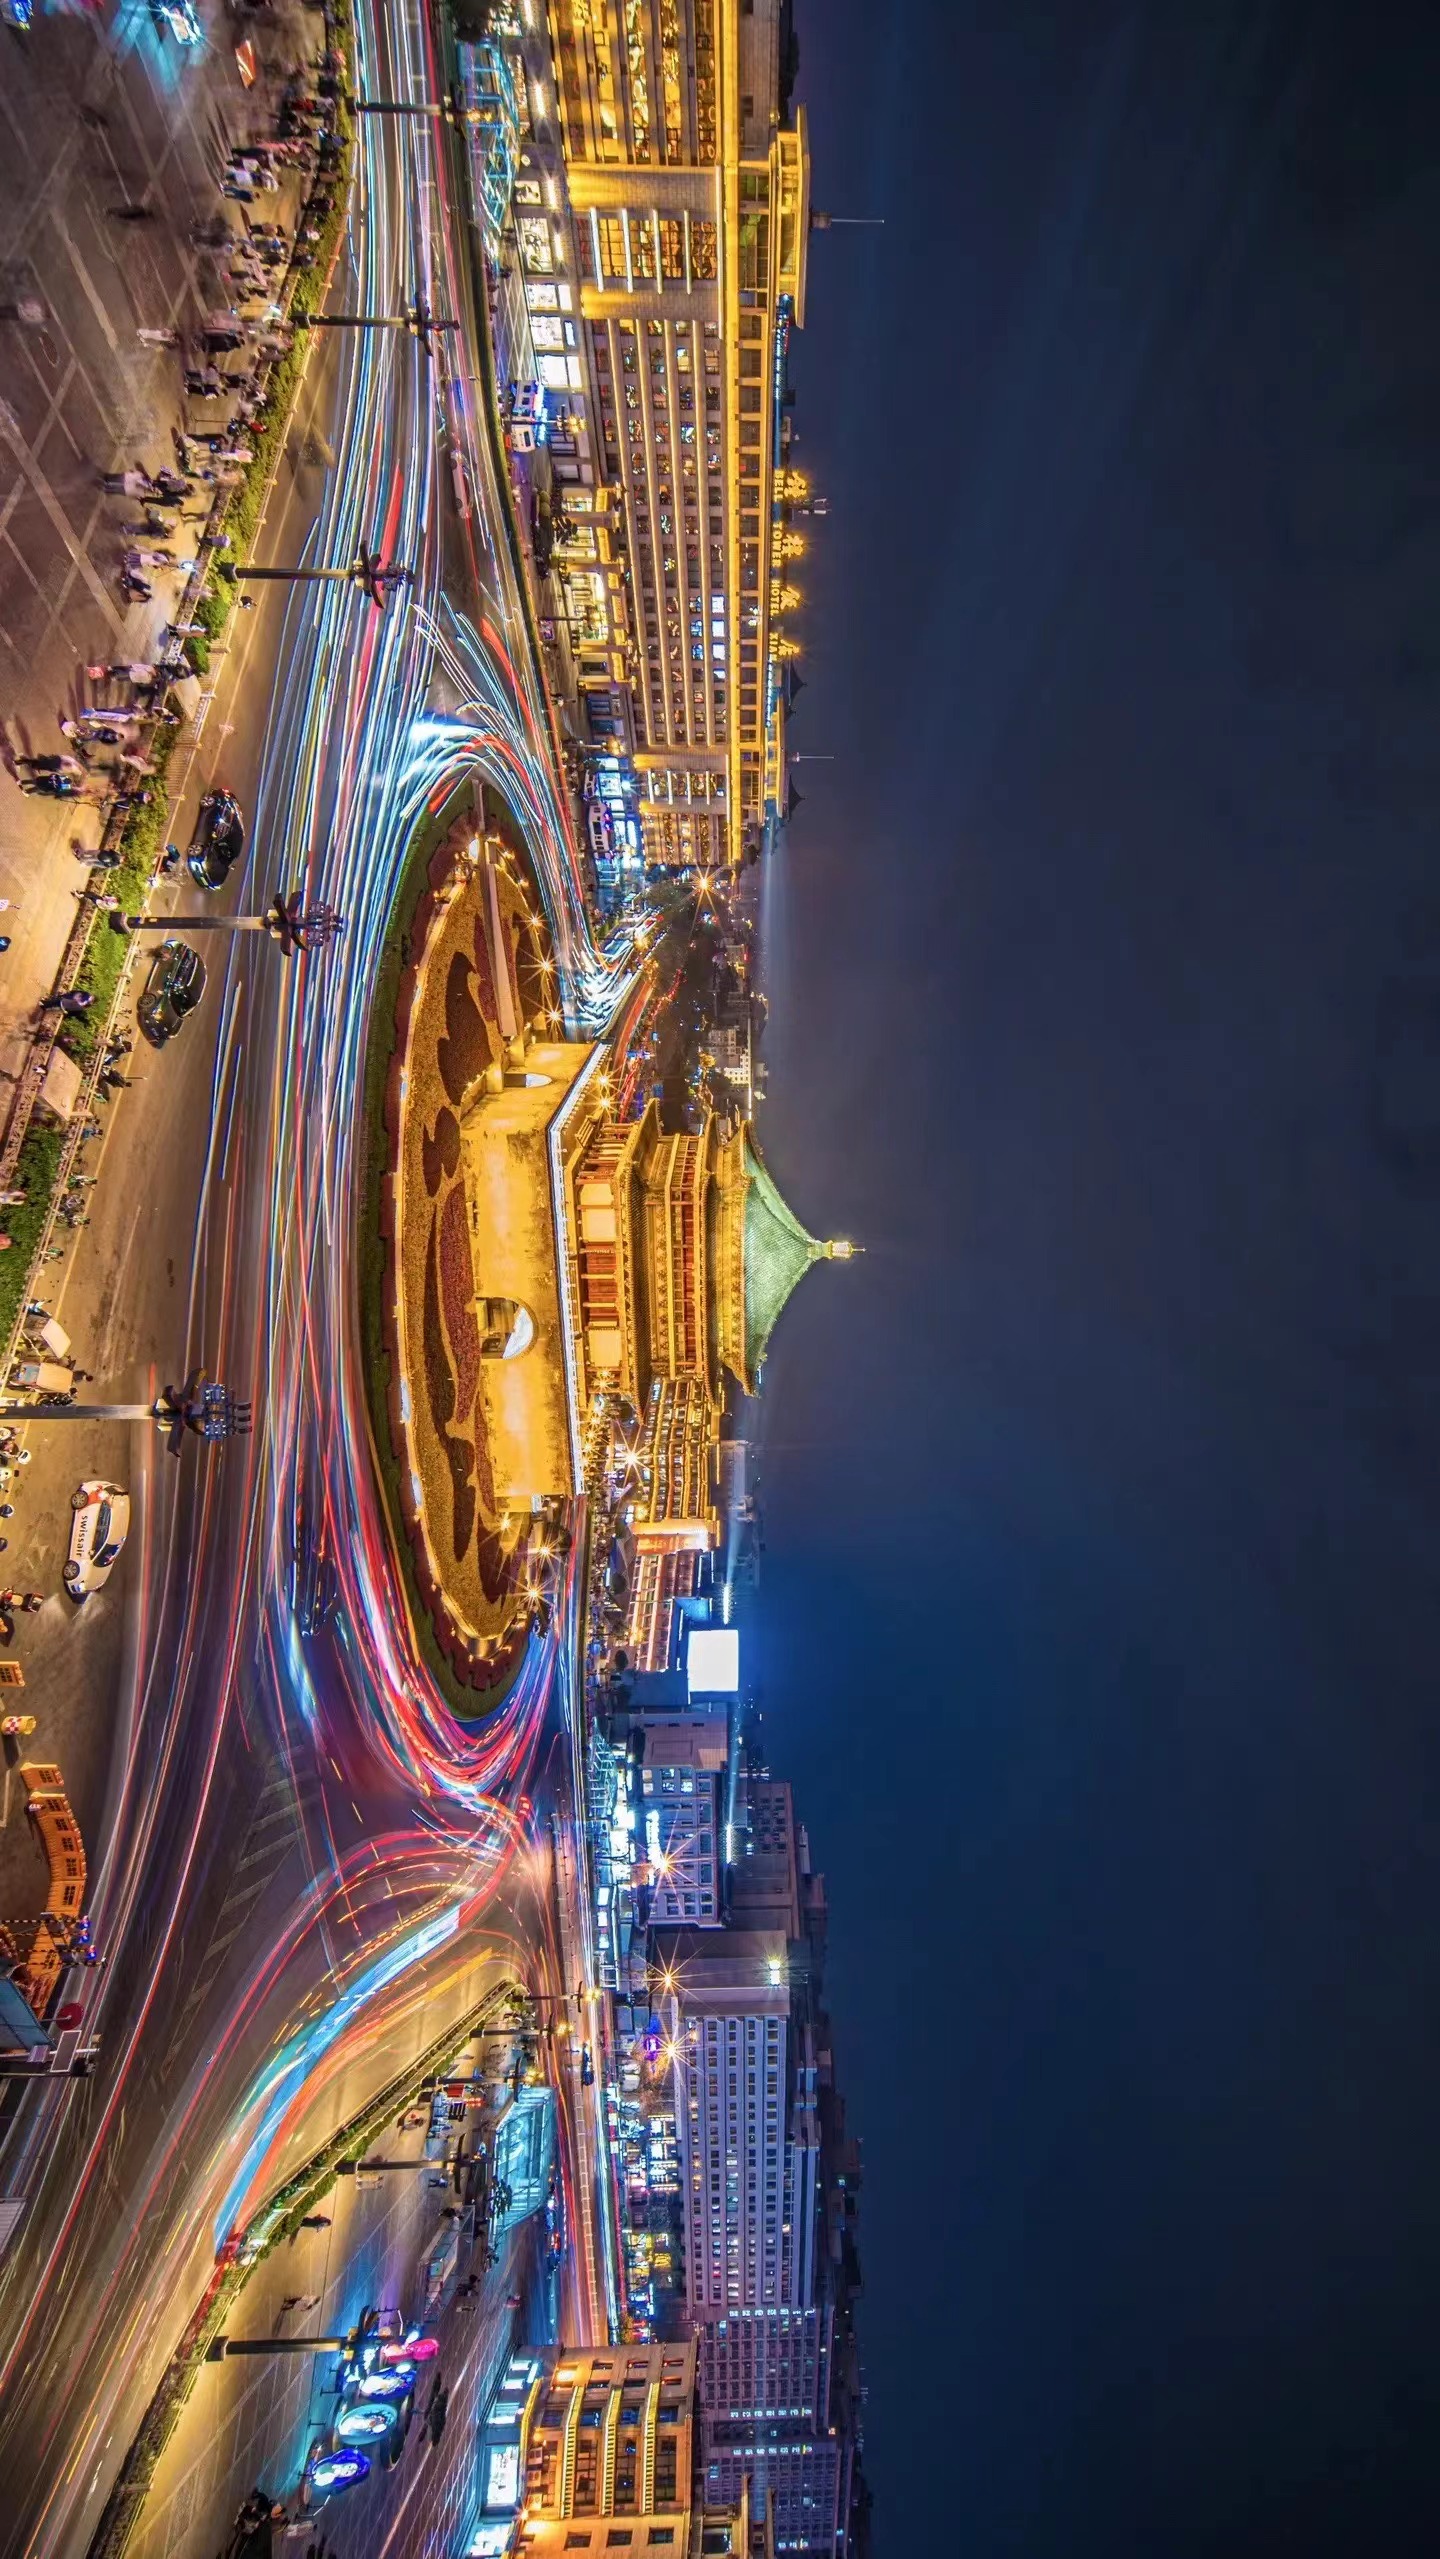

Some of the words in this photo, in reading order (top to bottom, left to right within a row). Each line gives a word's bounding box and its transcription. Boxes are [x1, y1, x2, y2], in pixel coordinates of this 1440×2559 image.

[774, 470, 784, 502] BELL
[772, 522, 783, 568] TOWER
[770, 580, 780, 616] HOTEL
[76, 1515, 88, 1558] swissair
